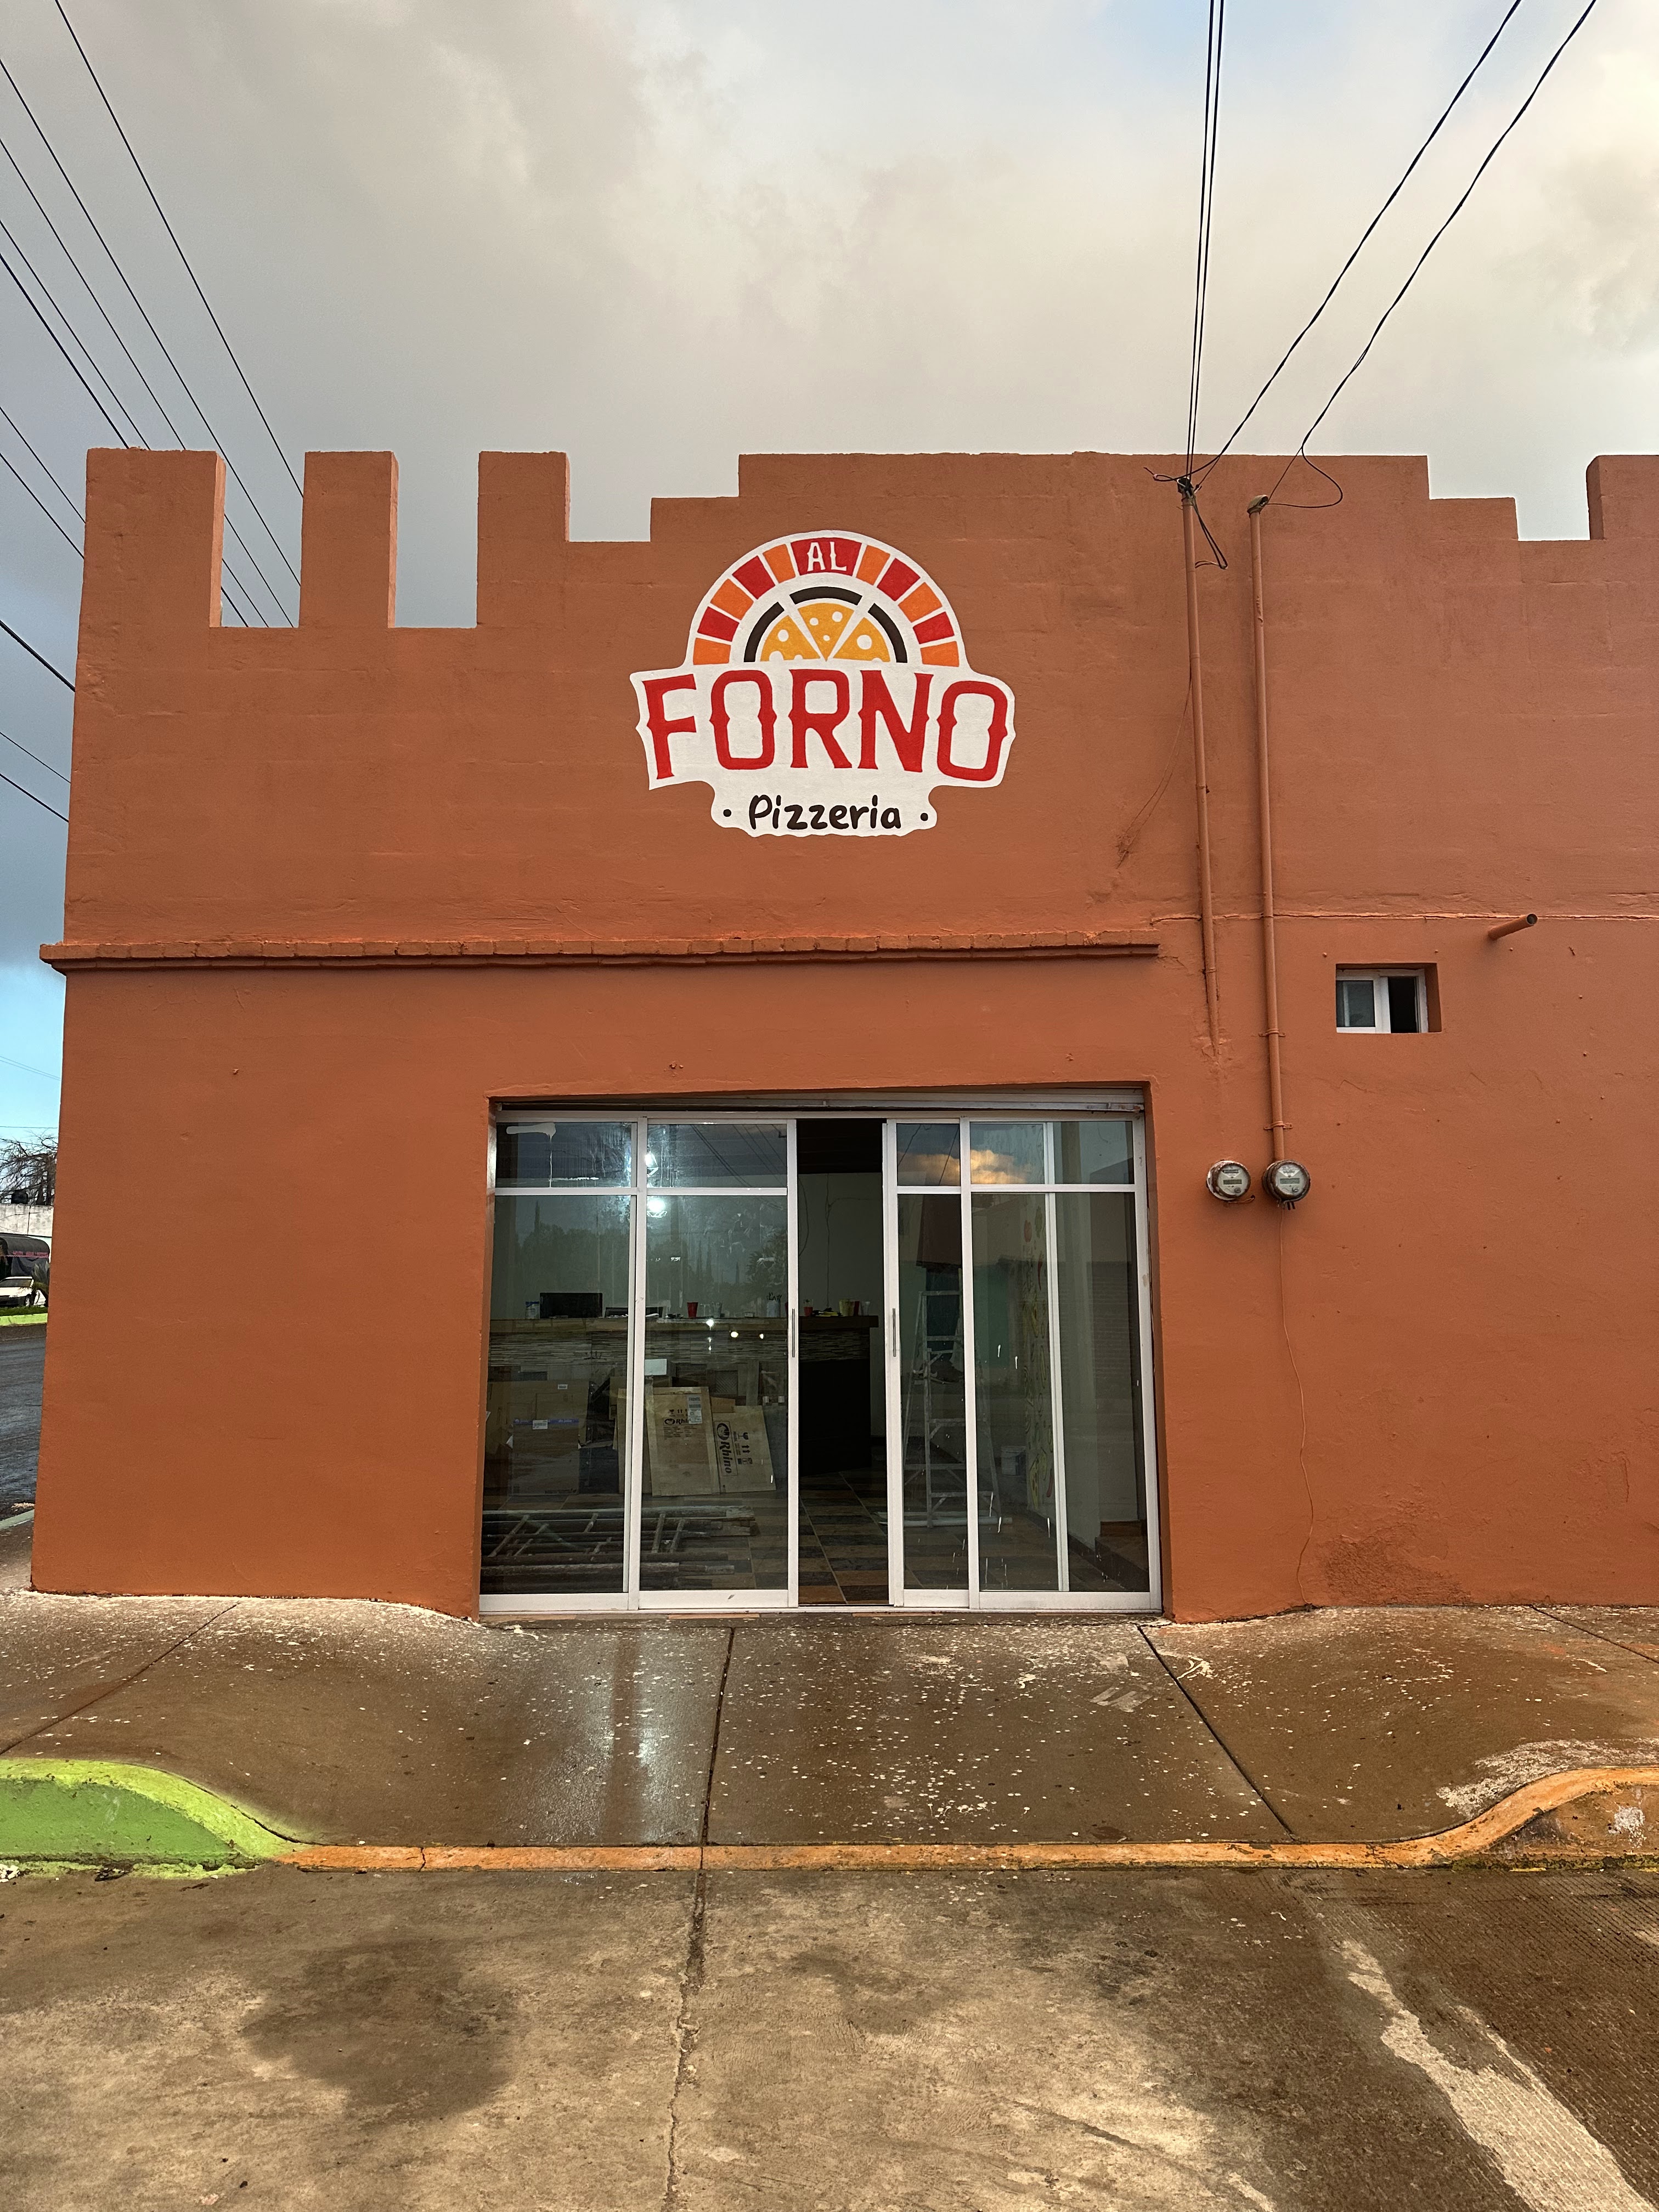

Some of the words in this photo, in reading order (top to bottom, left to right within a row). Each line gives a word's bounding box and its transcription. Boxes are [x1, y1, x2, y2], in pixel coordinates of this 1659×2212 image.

[806, 541, 847, 572] AL
[642, 669, 1008, 782] FORNO
[748, 794, 901, 830] Pizzeria
[719, 1441, 733, 1474] Rhino
